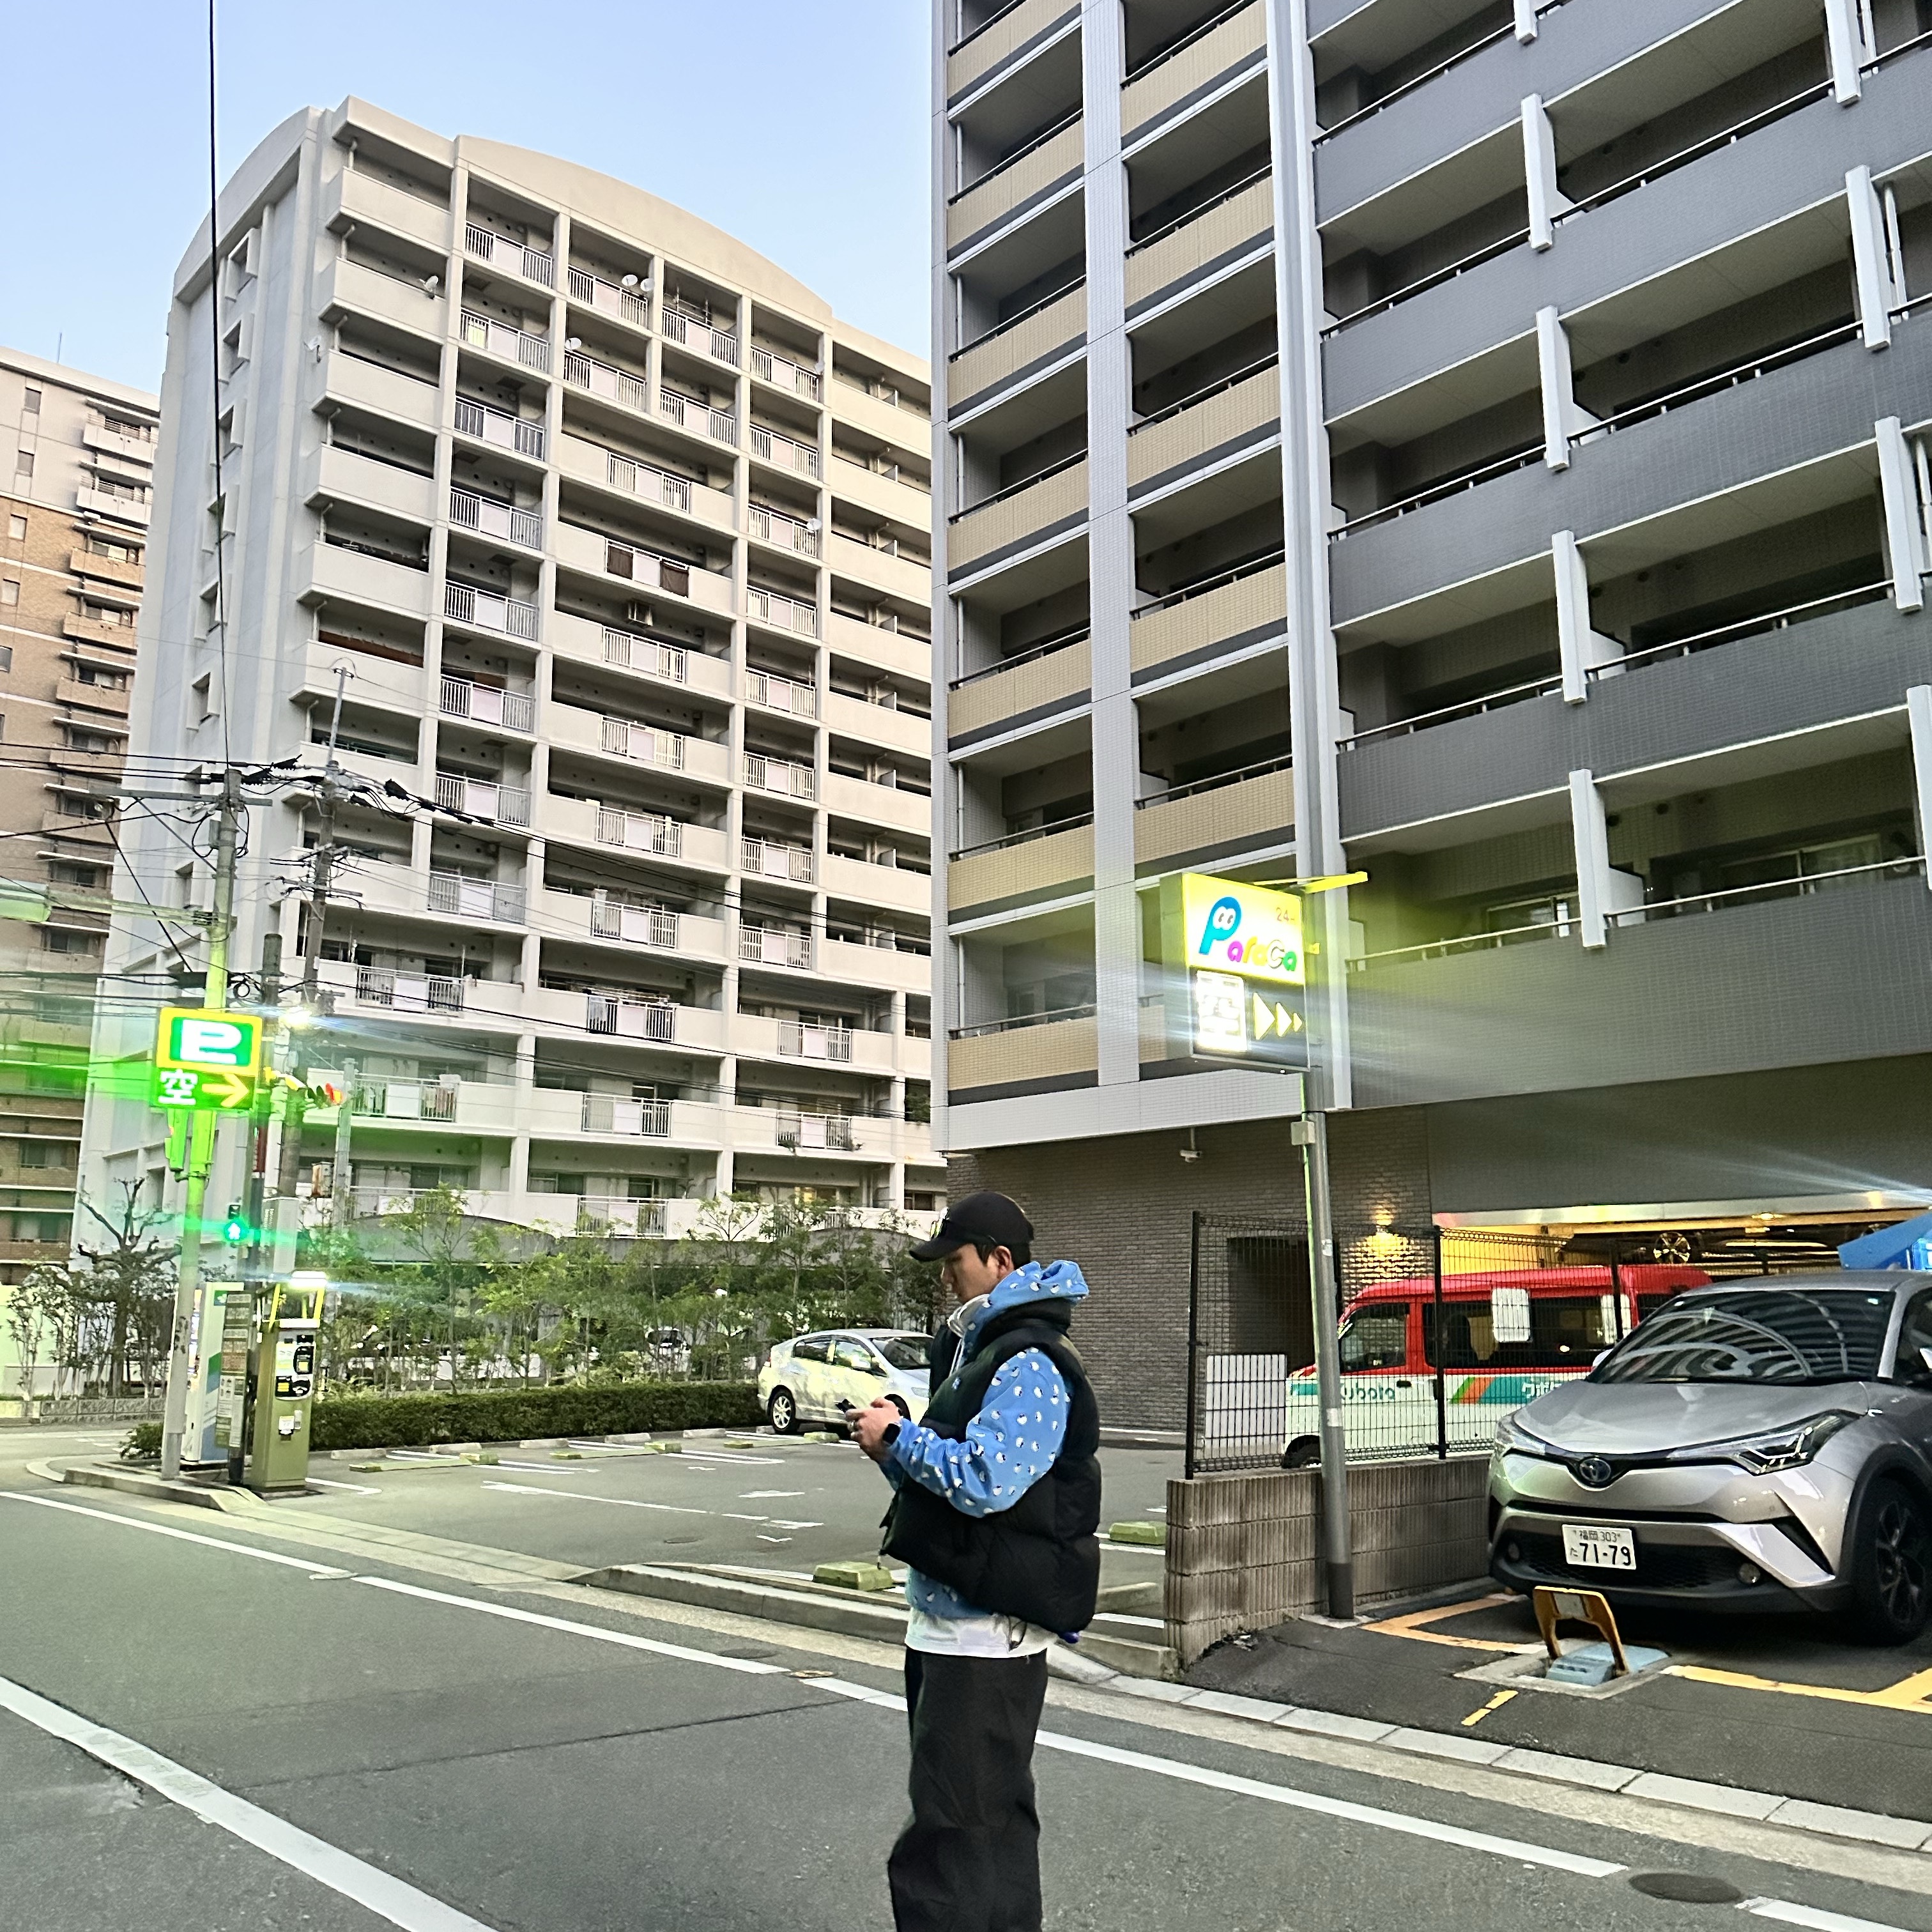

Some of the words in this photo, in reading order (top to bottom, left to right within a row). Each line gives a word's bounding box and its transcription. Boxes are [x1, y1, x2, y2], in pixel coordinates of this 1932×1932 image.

[158, 1068, 198, 1106] 空
[1340, 1382, 1395, 1400] ubota
[1600, 1531, 1617, 1542] 303
[1579, 1542, 1631, 1566] 71-79
